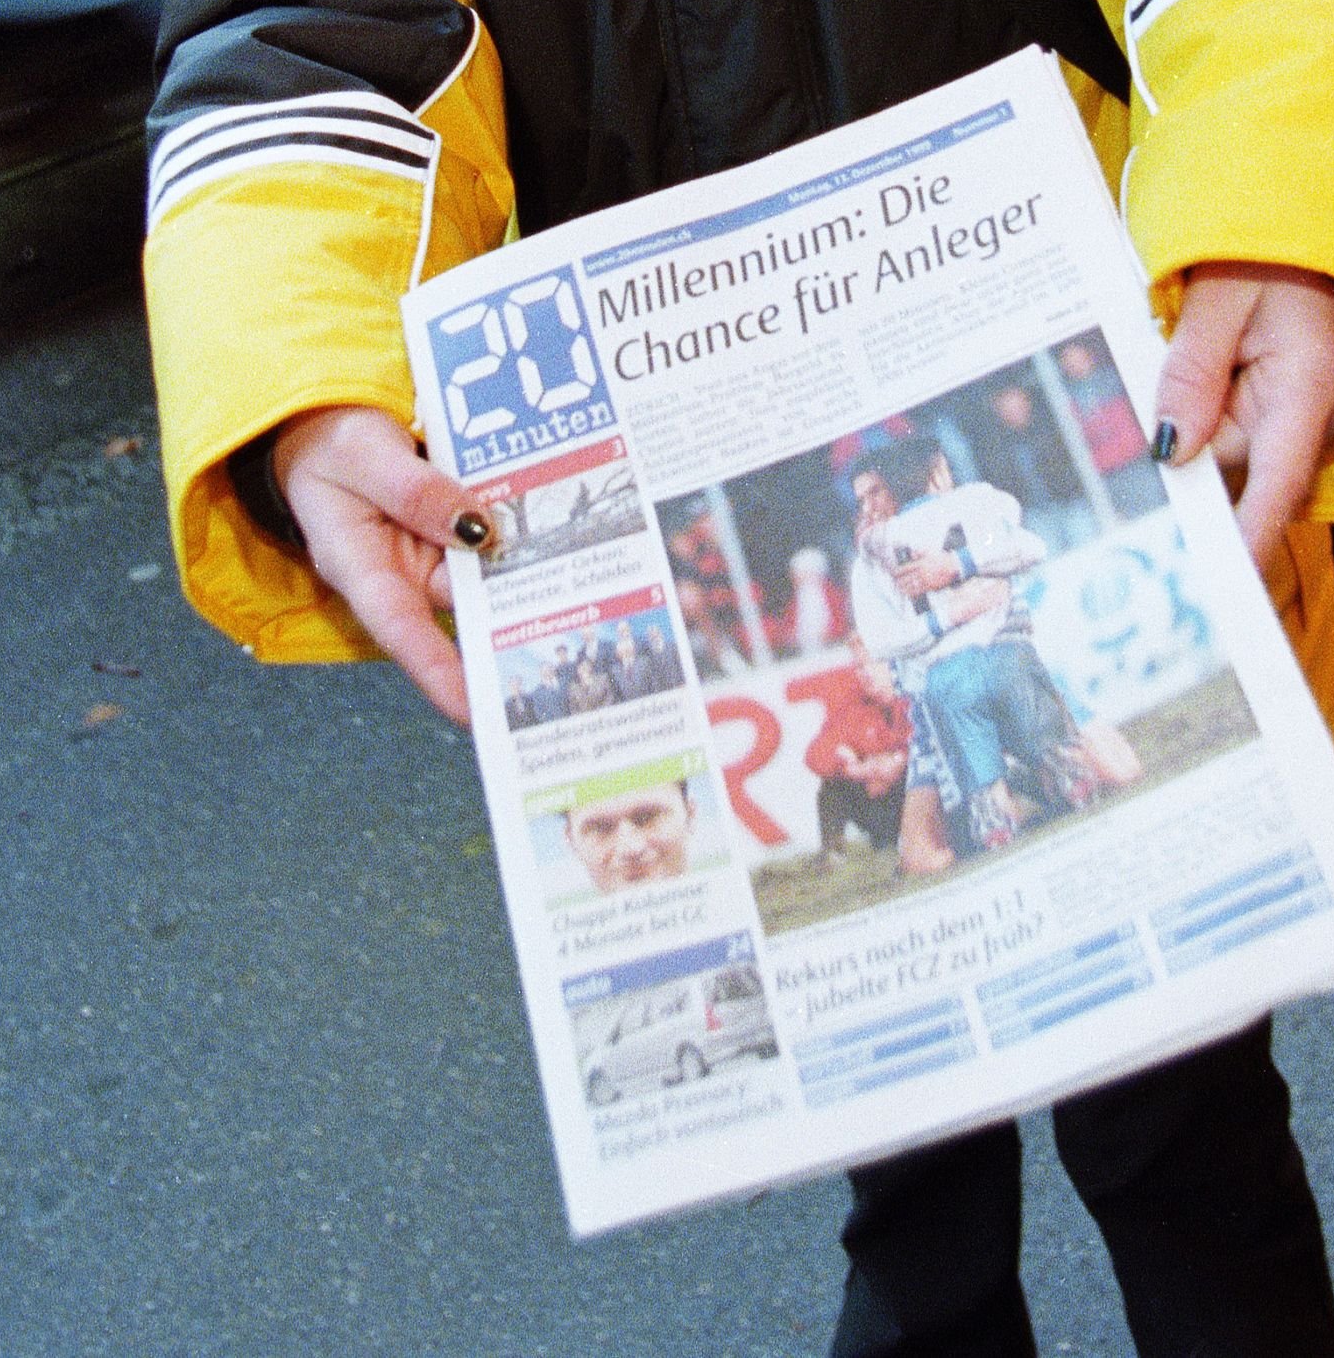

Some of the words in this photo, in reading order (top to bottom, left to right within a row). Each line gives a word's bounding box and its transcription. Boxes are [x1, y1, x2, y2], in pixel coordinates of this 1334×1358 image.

[598, 209, 867, 329] Millennium:
[880, 174, 953, 228] Die
[614, 304, 781, 382] Chance
[794, 269, 860, 333] für
[874, 193, 1045, 293] Anleger
[441, 271, 598, 438] 20
[462, 402, 614, 472] minuten
[487, 561, 566, 597] Schweizer
[493, 600, 600, 647] wettbewerb
[773, 949, 860, 992] Rekurs
[864, 926, 926, 966] nach
[927, 909, 986, 944] dem
[802, 968, 892, 1022] jubelte
[894, 950, 945, 988] FCZ
[946, 943, 979, 971] zu
[979, 911, 1048, 964] früh?
